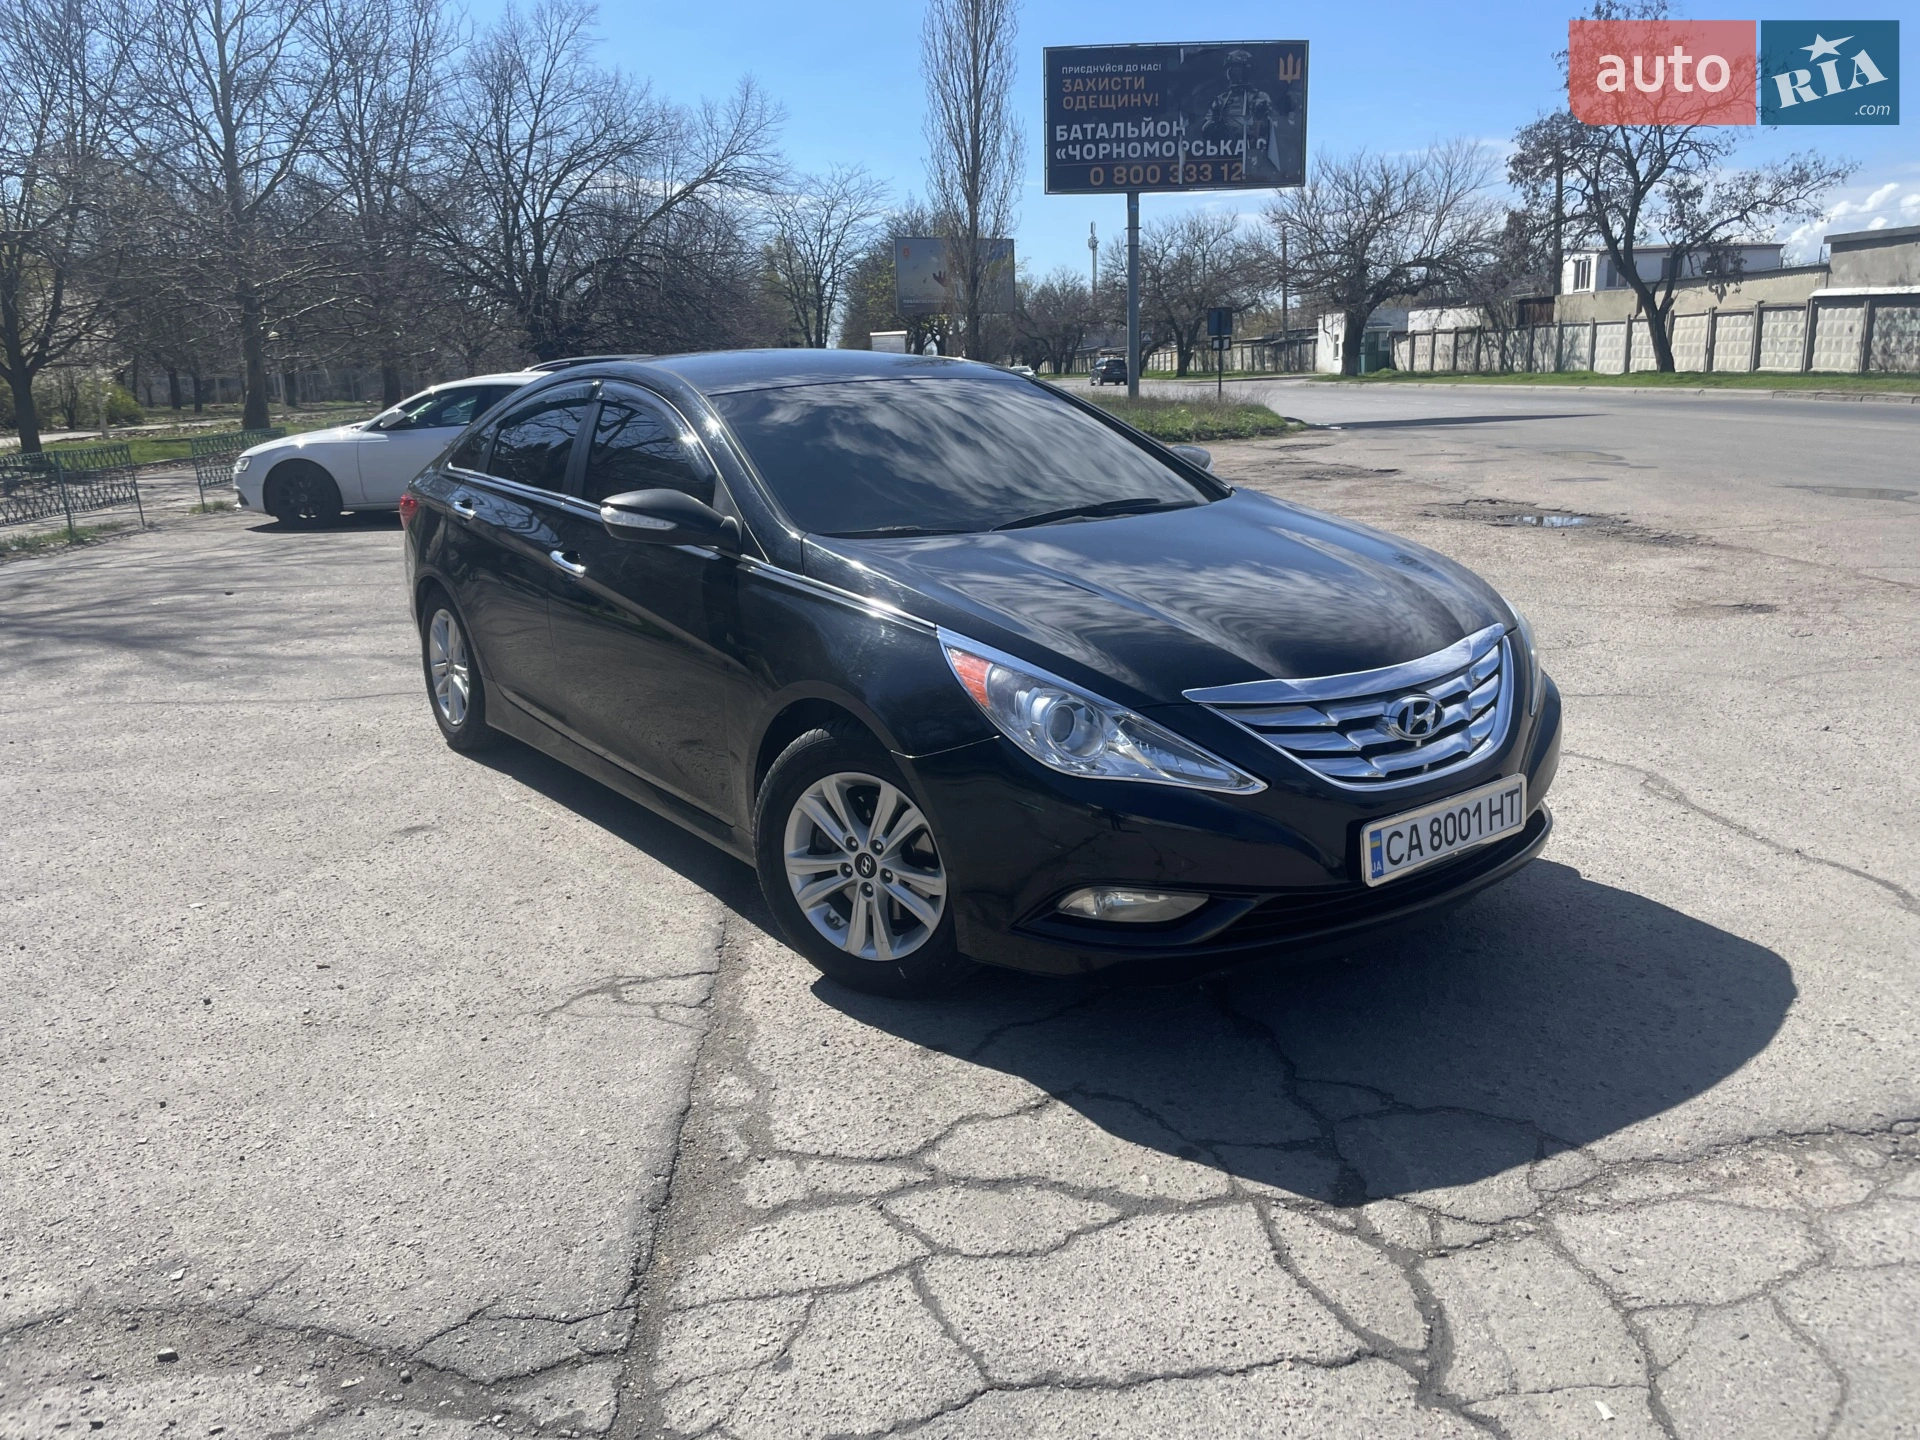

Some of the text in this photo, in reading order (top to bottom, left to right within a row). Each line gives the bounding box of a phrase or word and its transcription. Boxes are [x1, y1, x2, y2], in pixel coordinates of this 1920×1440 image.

[1061, 63, 1162, 75] ПРИЄДНУЙСЯ ДО НАС!
[1062, 76, 1145, 93] ЗАХИСТИ
[1062, 93, 1159, 111] ОДЕЩИНУ!
[1055, 117, 1186, 142] БАТАЛЬЙОН
[1089, 166, 1105, 186] 0
[1113, 164, 1161, 185] 800
[1169, 162, 1213, 184] 333
[1386, 788, 1520, 866] CA 8001 HT
